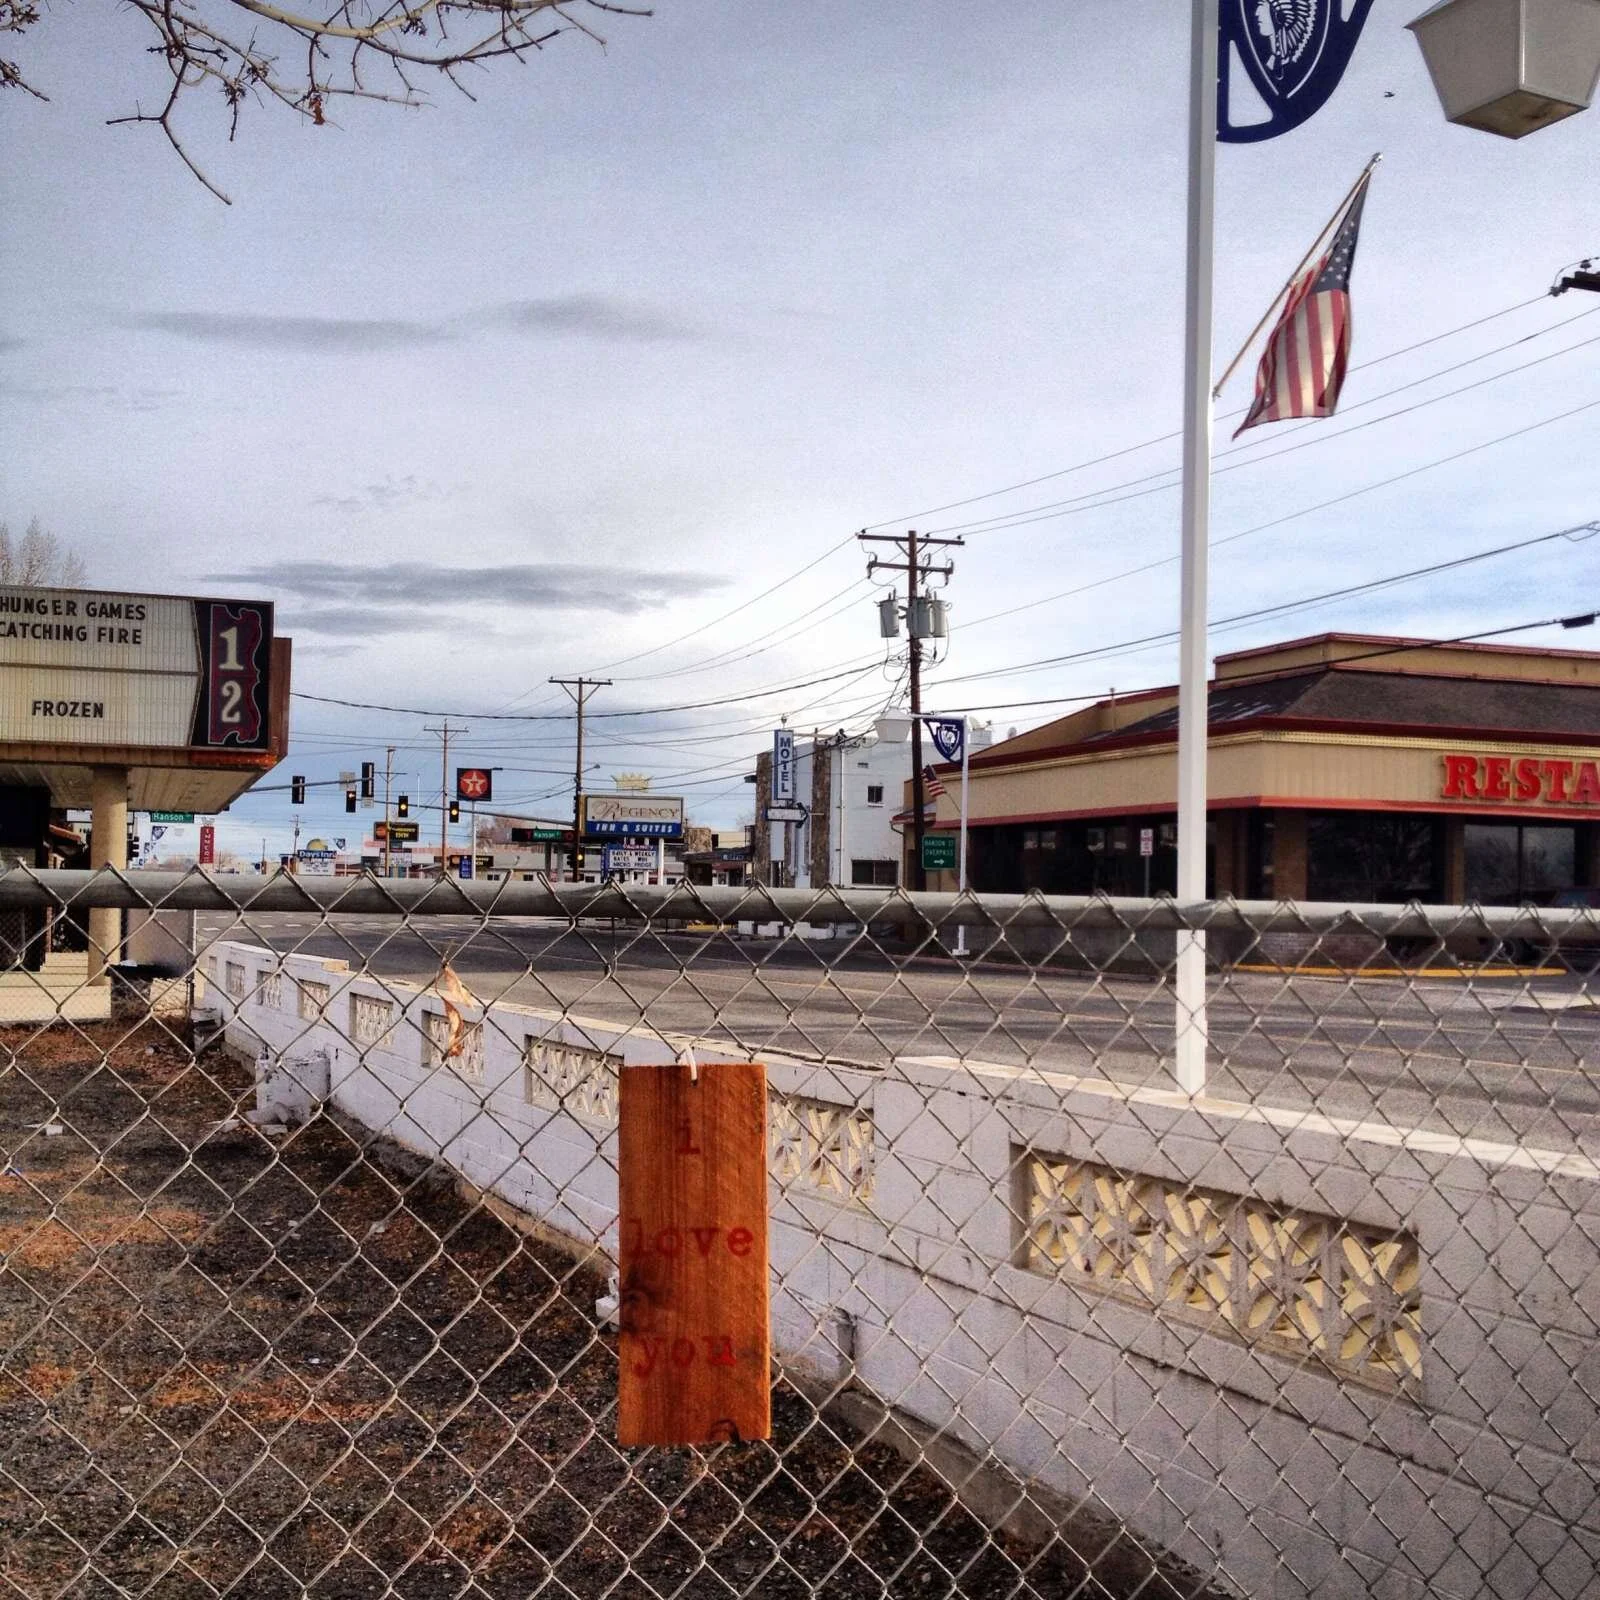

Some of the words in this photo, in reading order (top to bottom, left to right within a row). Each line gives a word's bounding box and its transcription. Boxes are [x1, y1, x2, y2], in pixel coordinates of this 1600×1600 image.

[0, 596, 77, 617] HUNGER
[86, 601, 146, 621] GAMES
[0, 621, 87, 642] CATCHING
[97, 627, 142, 645] FIRE
[218, 625, 244, 671] 1
[32, 700, 104, 718] FROZEN
[221, 680, 242, 723] 2
[780, 736, 791, 793] MOTEL
[1443, 754, 1600, 803] RESTA
[153, 812, 184, 821] Hanson
[596, 823, 616, 832] INN
[622, 824, 628, 832] &
[635, 824, 673, 833] SUITES
[299, 850, 320, 858] Days
[627, 1218, 754, 1259] love
[632, 1335, 738, 1378] you
